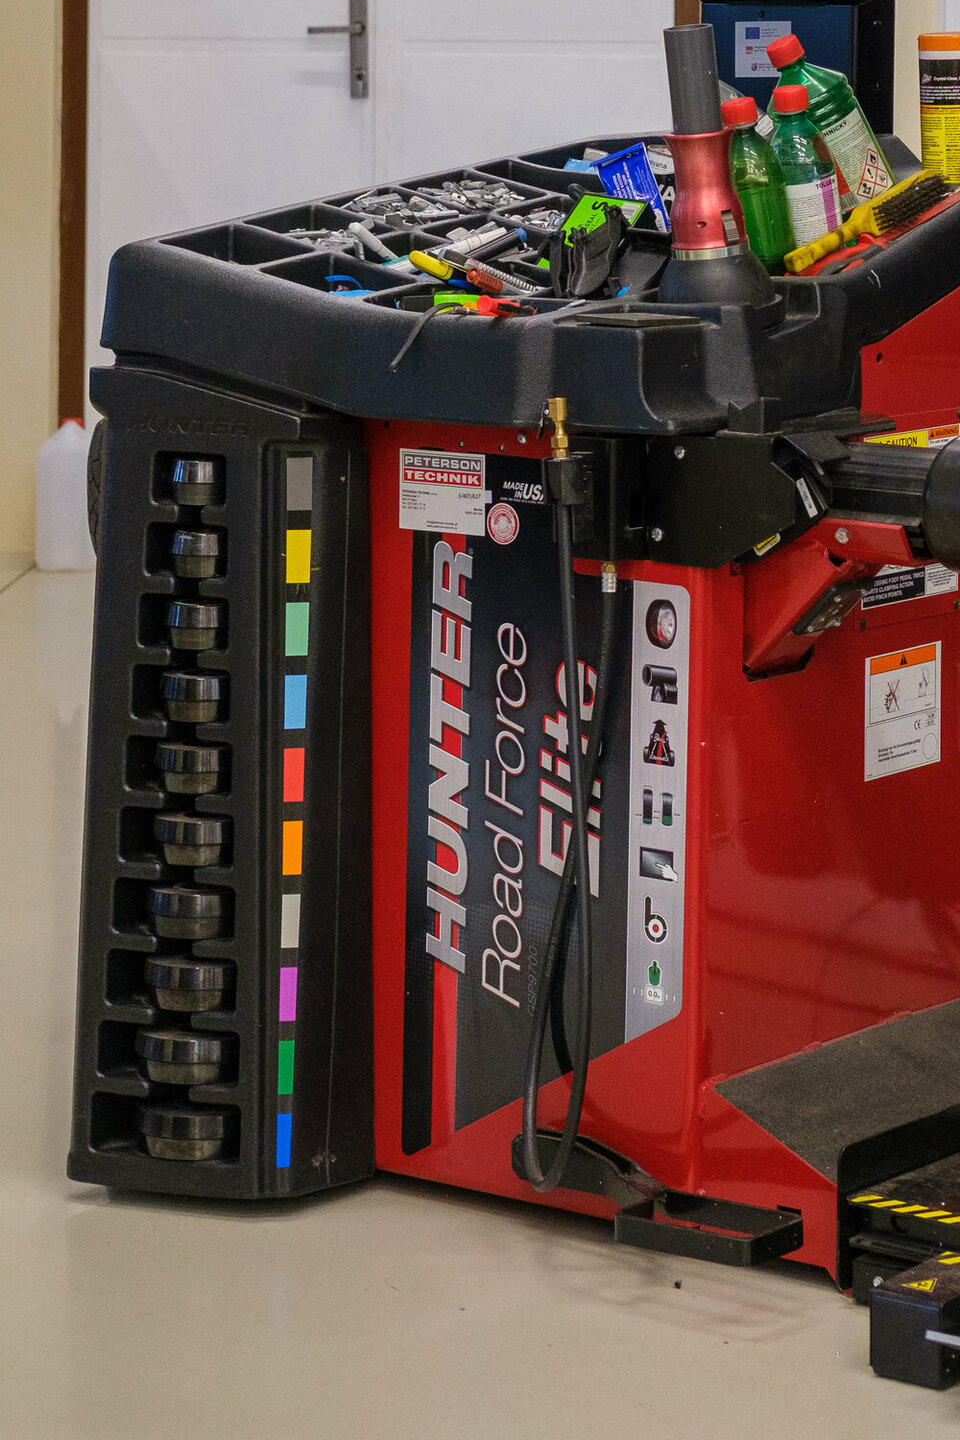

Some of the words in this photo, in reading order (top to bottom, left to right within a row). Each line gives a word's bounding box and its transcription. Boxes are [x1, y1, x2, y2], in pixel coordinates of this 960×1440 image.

[404, 455, 481, 471] PETERSON
[404, 470, 480, 486] TECHNIK
[503, 481, 525, 491] MADE
[514, 490, 523, 499] IN
[484, 621, 528, 817] Force
[425, 540, 474, 975] HUNTER
[481, 820, 524, 1009] Road
